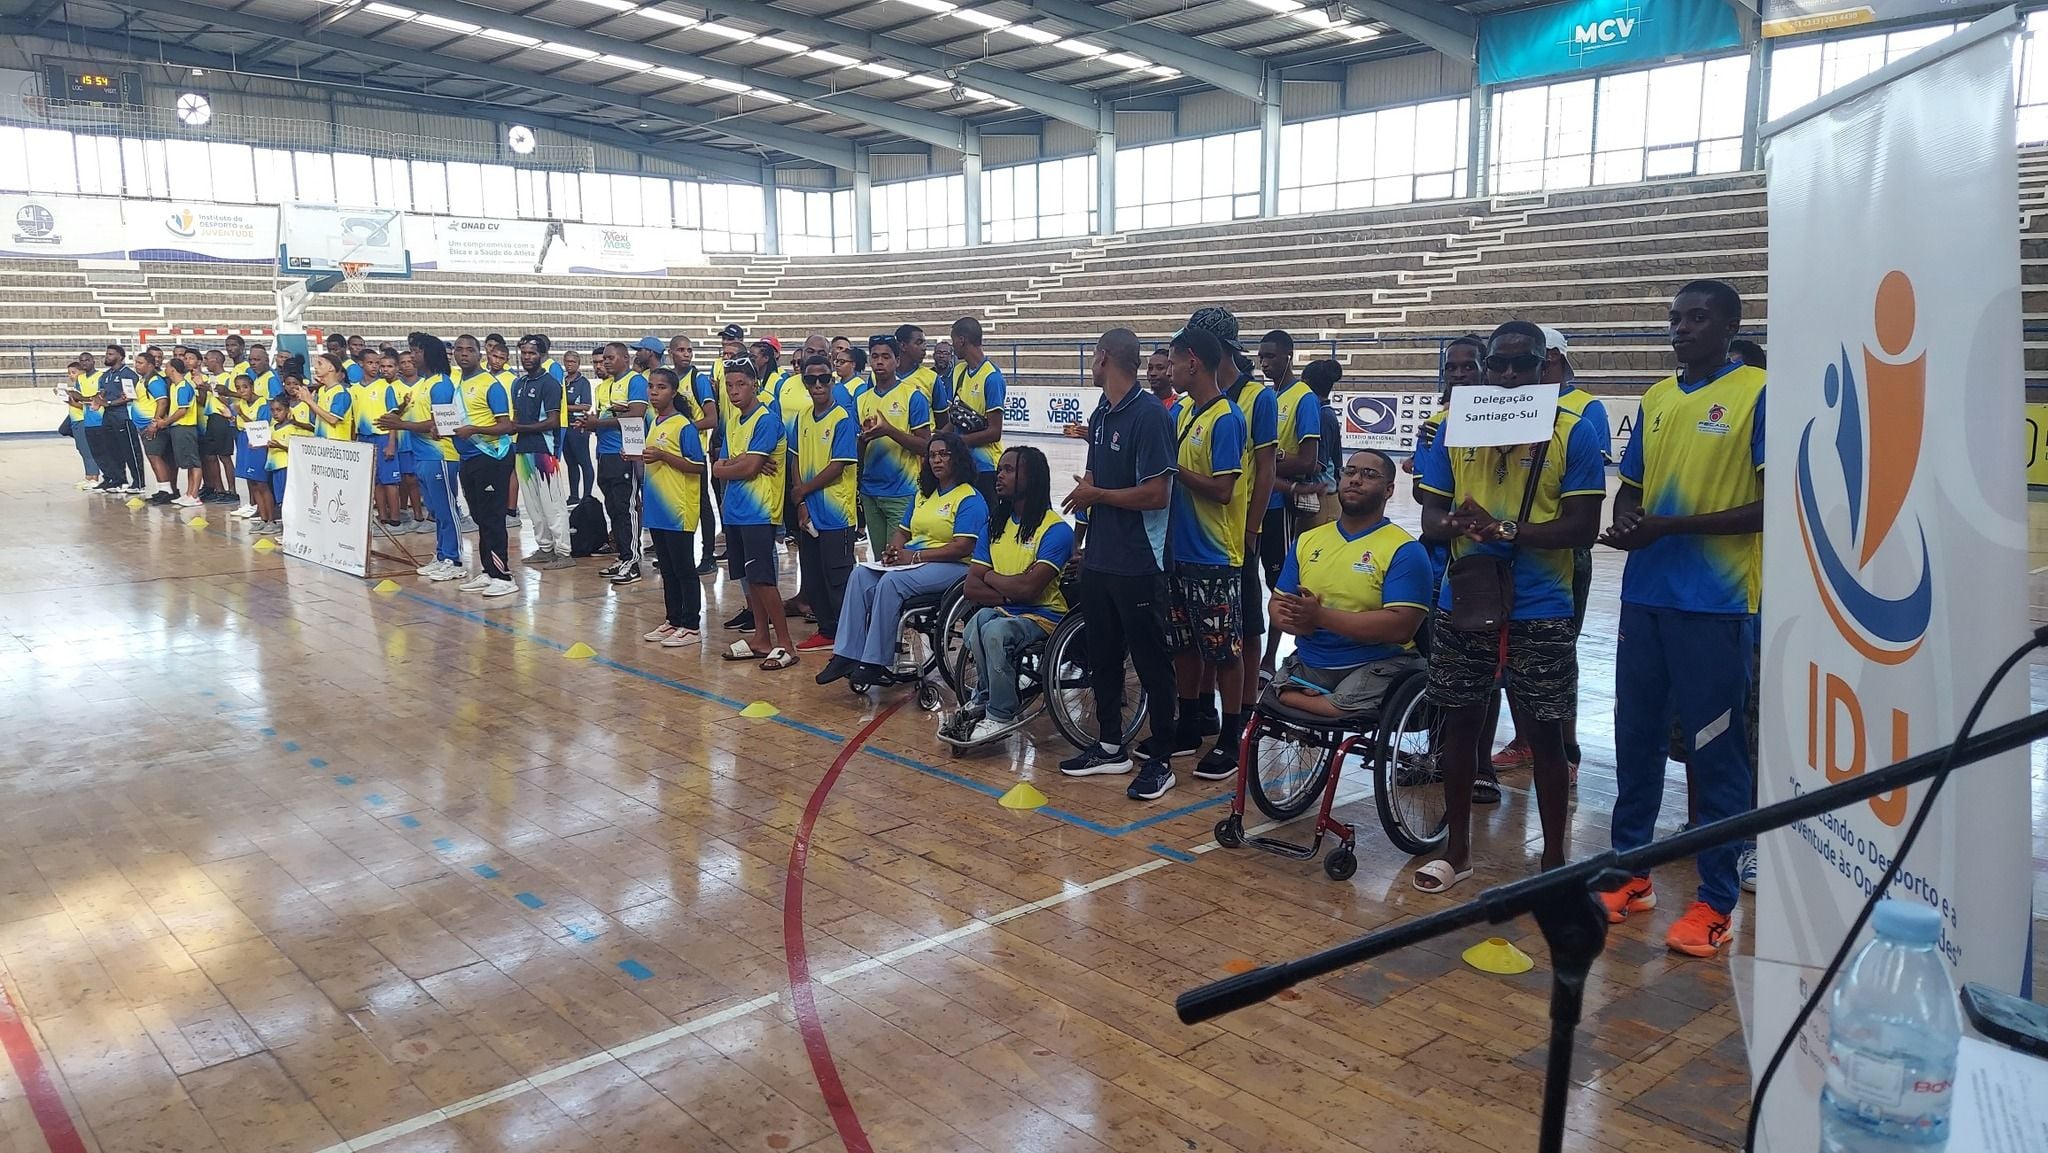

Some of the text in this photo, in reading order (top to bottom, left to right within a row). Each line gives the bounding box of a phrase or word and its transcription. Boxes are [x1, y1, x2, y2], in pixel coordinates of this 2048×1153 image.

[1575, 17, 1635, 44] MCV
[199, 214, 231, 222] Instituto
[461, 221, 500, 231] ONAD CV
[200, 229, 254, 238] JUVENTUDE
[448, 240, 462, 248] Um
[463, 241, 512, 250] compromisso
[513, 249, 536, 257] Atleta
[1004, 396, 1027, 409] ABO
[1049, 398, 1080, 411] CABO
[1473, 393, 1534, 405] Delegação
[1003, 408, 1030, 421] ERDE
[1047, 410, 1083, 423] VERDE
[1464, 409, 1538, 422] Santiago-Sul
[301, 443, 317, 456] TODOS
[311, 464, 349, 480] PROTAGONISTAS
[1839, 849, 1851, 879] às
[1857, 838, 1865, 855] o
[1942, 898, 1949, 918] e
